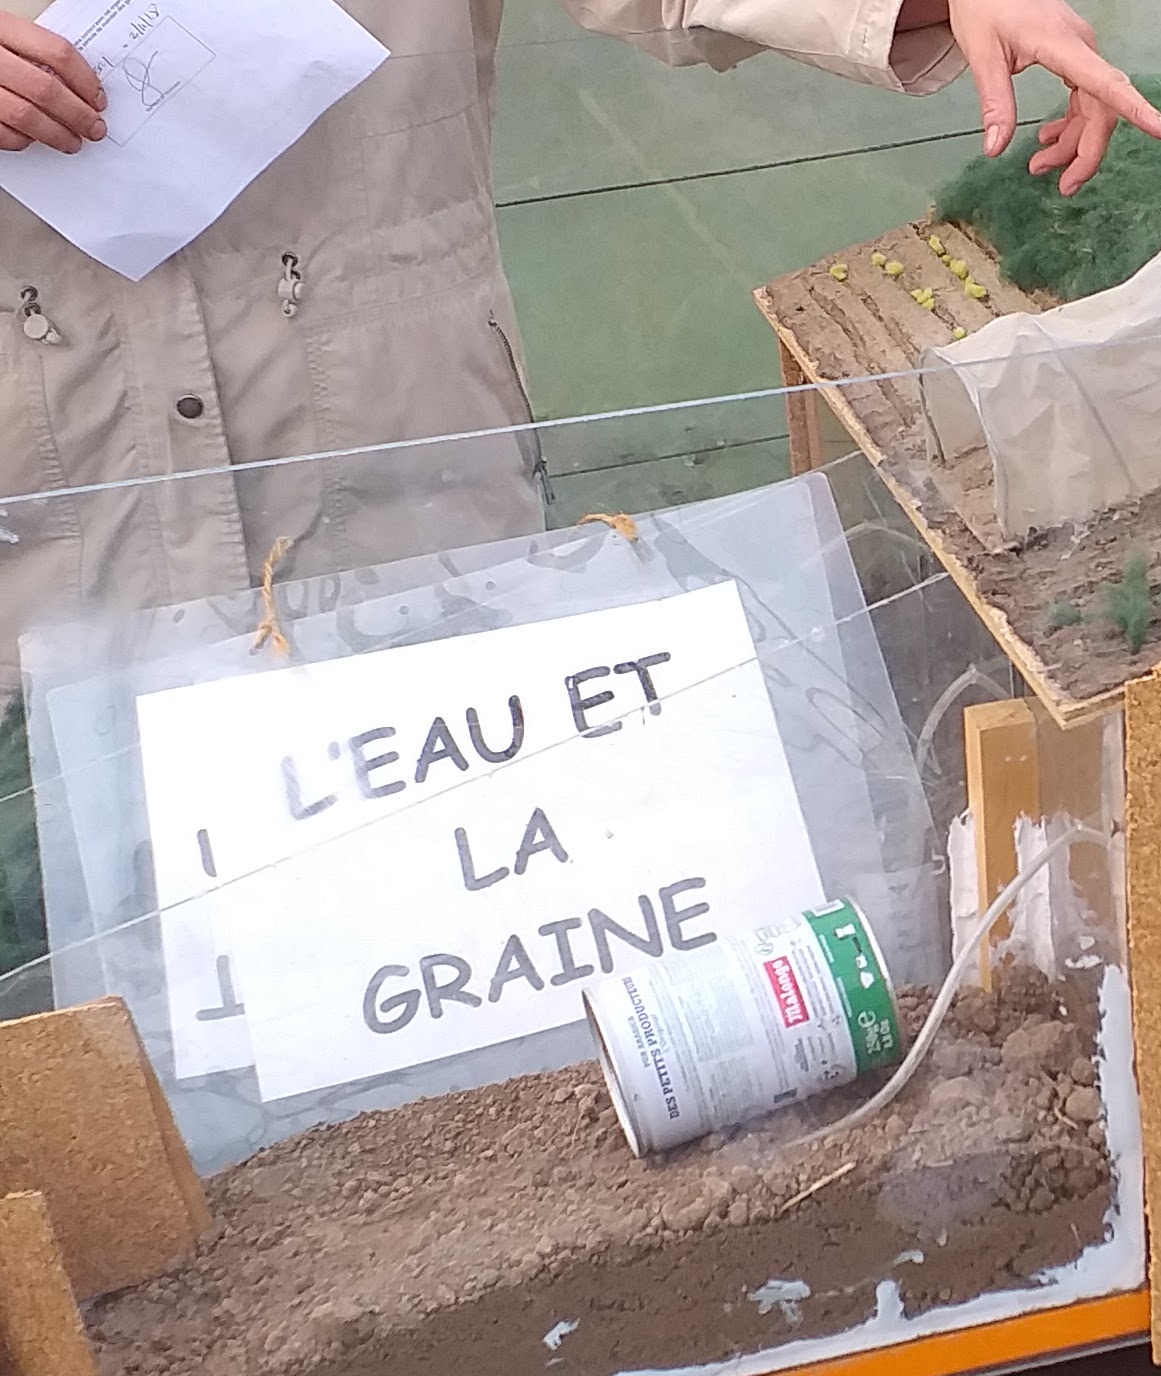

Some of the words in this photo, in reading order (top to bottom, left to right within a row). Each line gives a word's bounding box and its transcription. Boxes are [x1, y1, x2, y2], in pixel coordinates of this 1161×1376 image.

[281, 695, 524, 820] L'EAU
[564, 651, 673, 737] ET
[454, 806, 569, 892] LA
[361, 877, 718, 1034] GRAINE
[769, 958, 804, 1023] Malongo
[649, 1047, 673, 1095] PETITS
[663, 1095, 680, 1119] DES
